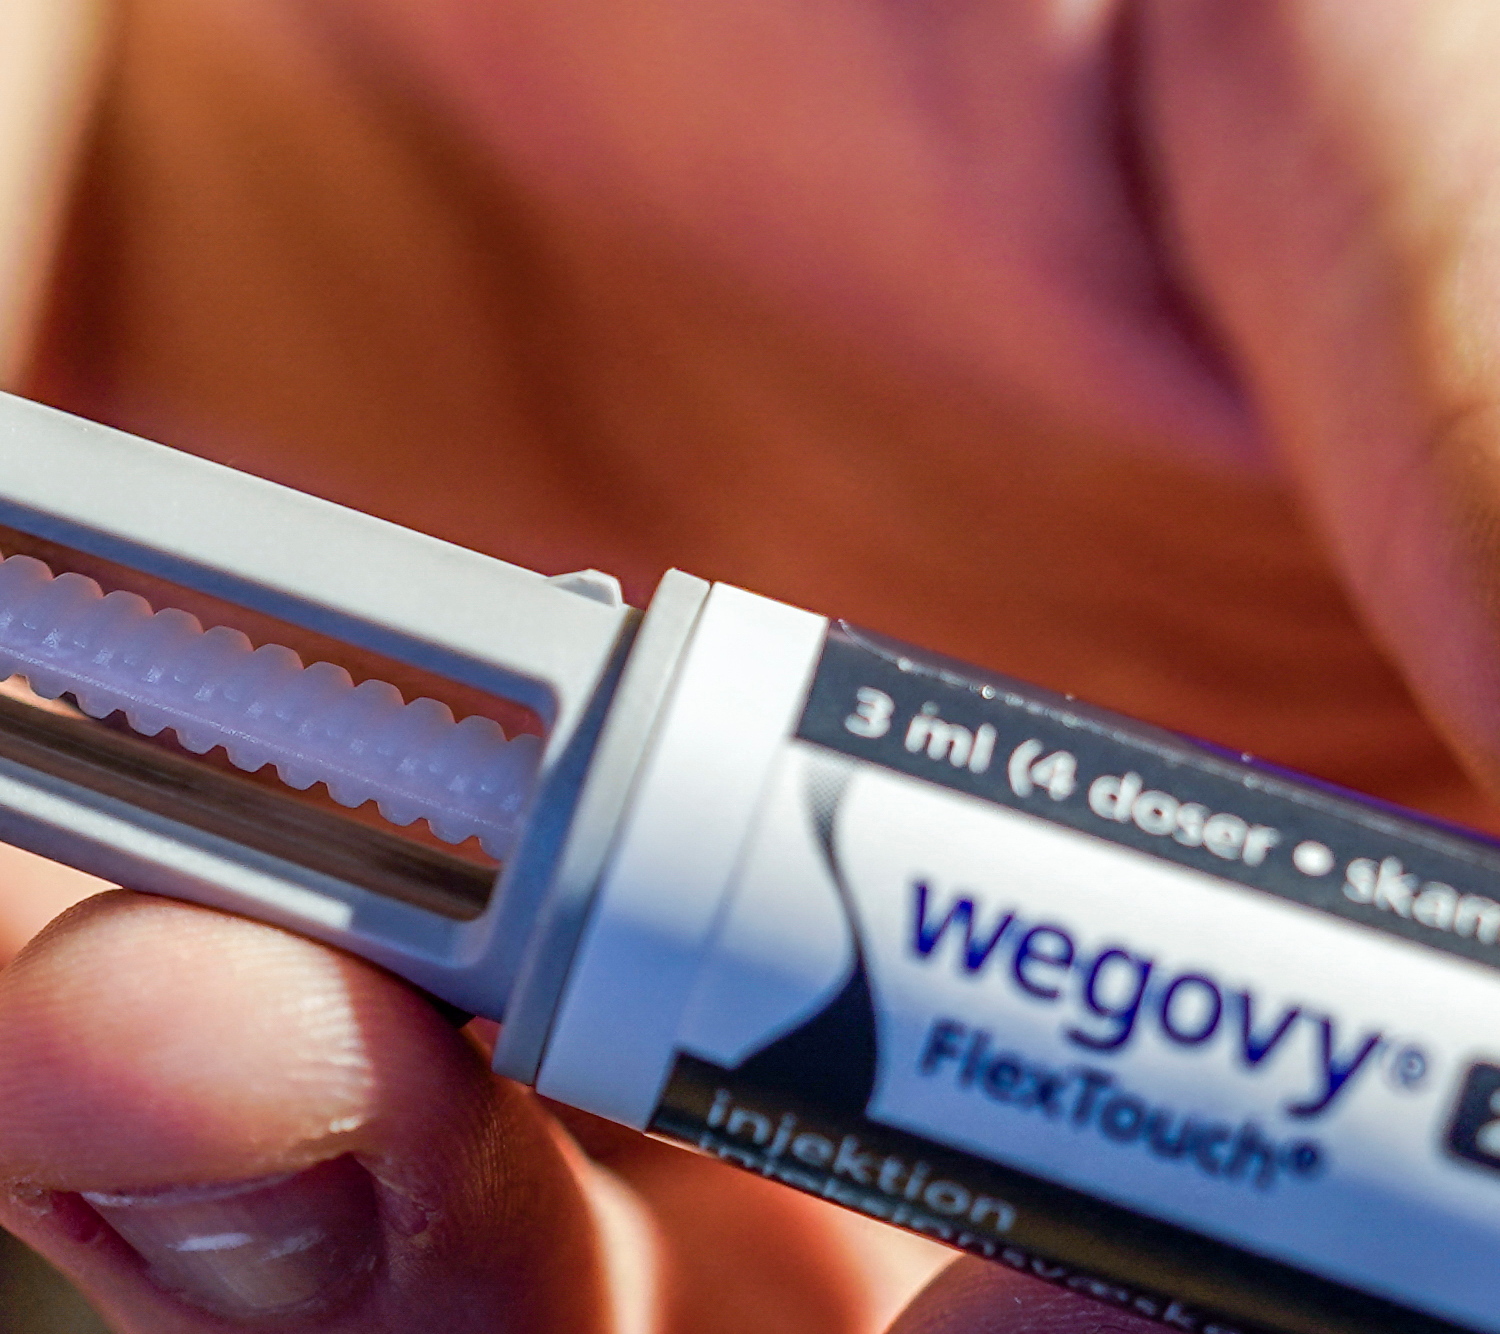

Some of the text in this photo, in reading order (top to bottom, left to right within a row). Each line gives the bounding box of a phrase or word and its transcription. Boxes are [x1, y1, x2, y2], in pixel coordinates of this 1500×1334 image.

[844, 686, 895, 739] 3
[905, 704, 996, 774] ml
[1007, 738, 1079, 802] (4
[1088, 772, 1284, 866] doser
[705, 1087, 1017, 1233] injektion
